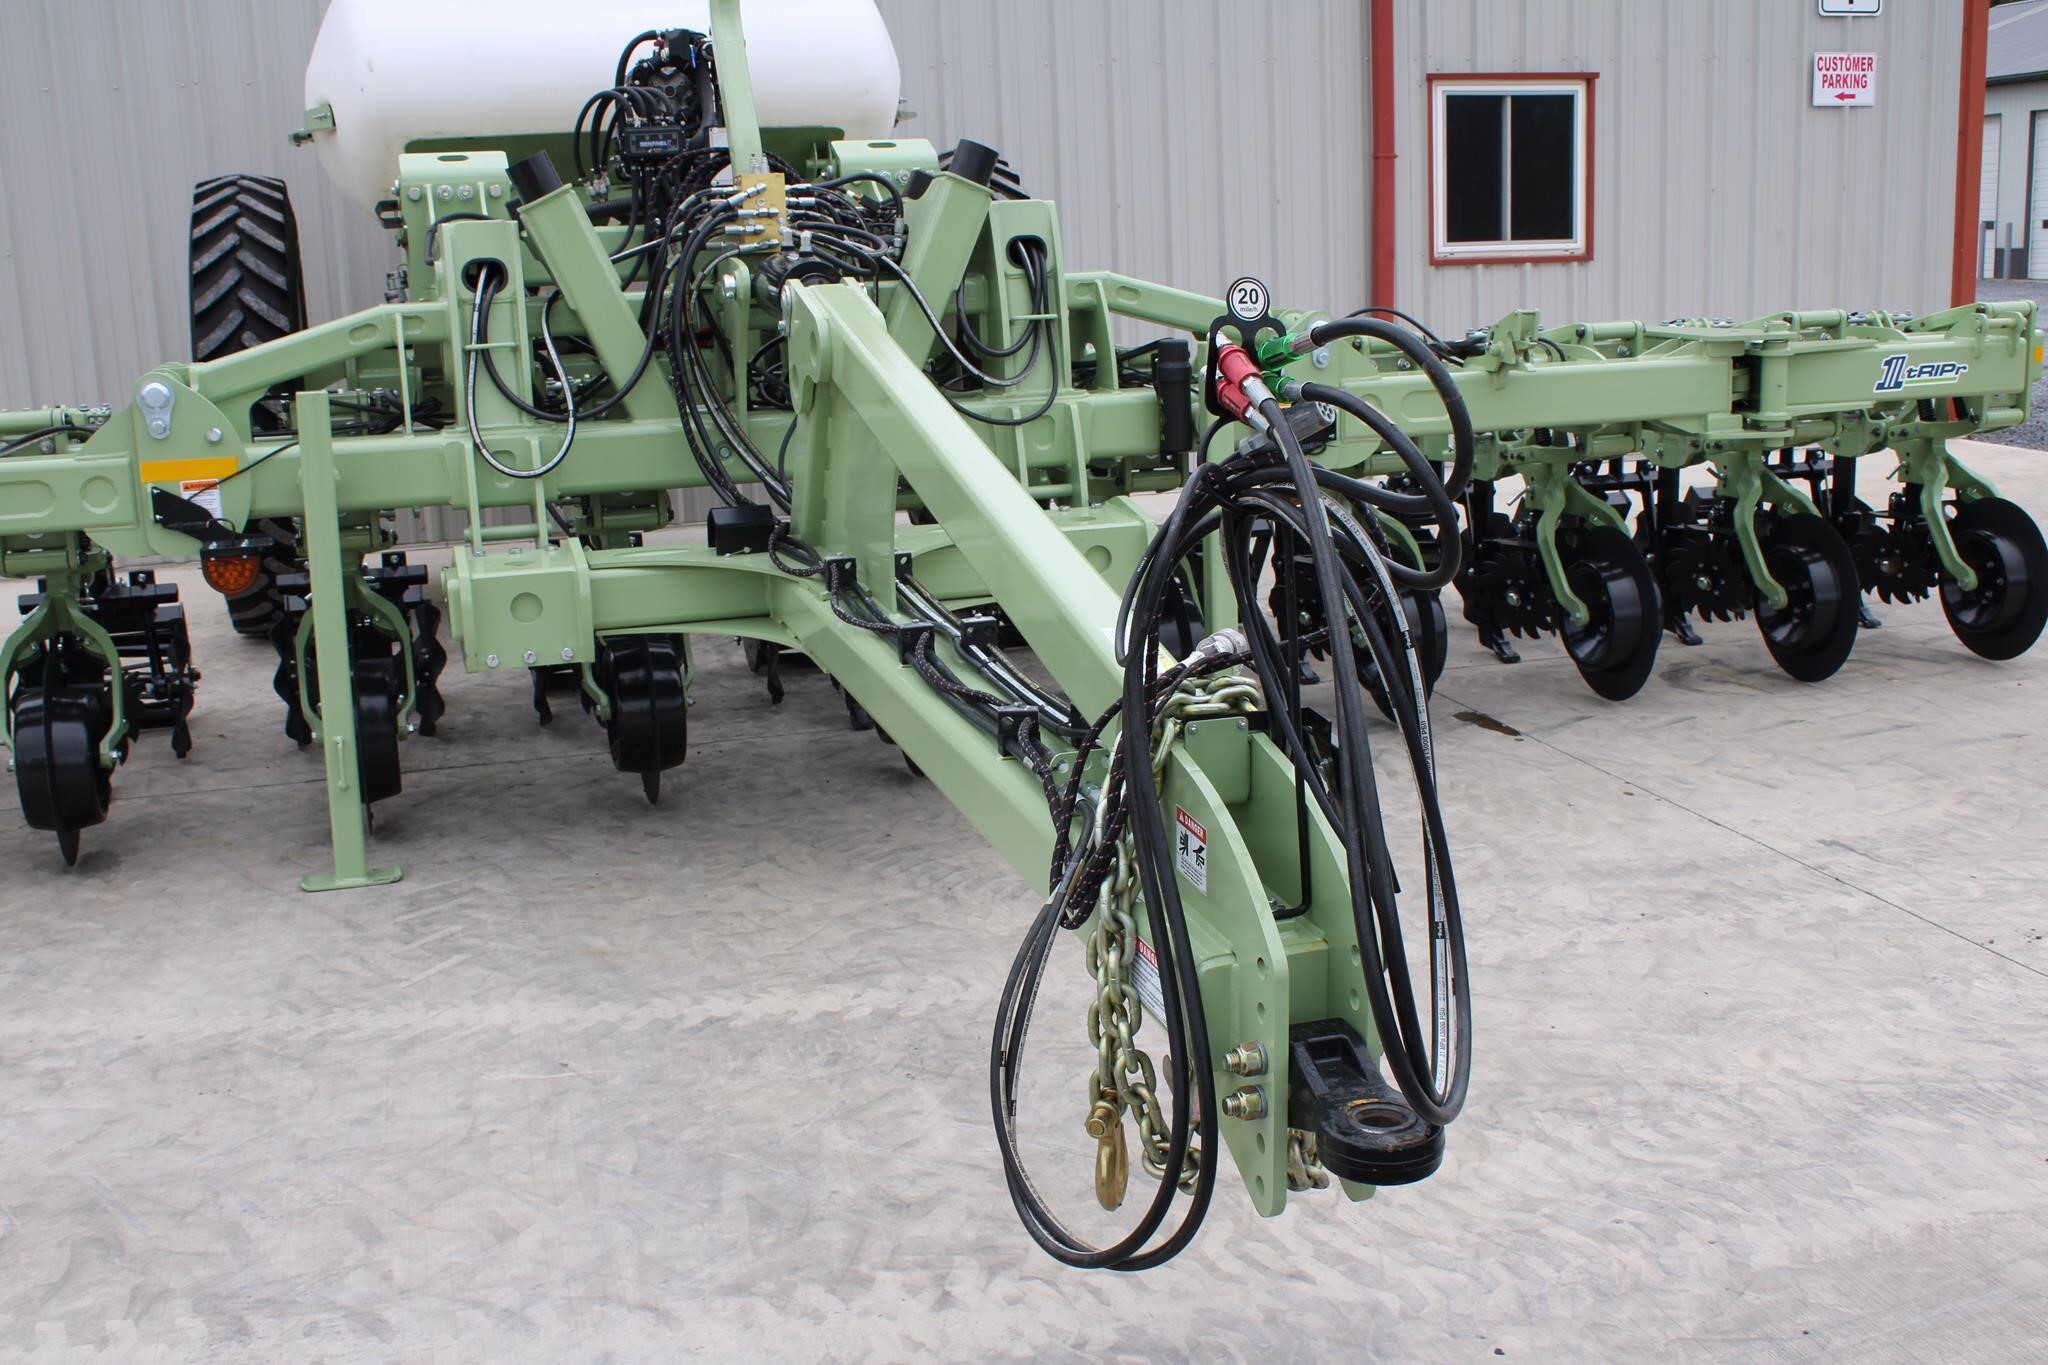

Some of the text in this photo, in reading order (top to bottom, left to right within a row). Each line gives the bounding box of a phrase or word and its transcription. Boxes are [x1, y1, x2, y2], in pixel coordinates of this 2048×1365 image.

[1817, 56, 1873, 72] CUSTOMER
[1822, 74, 1868, 89] PARKING
[1237, 287, 1259, 305] 20
